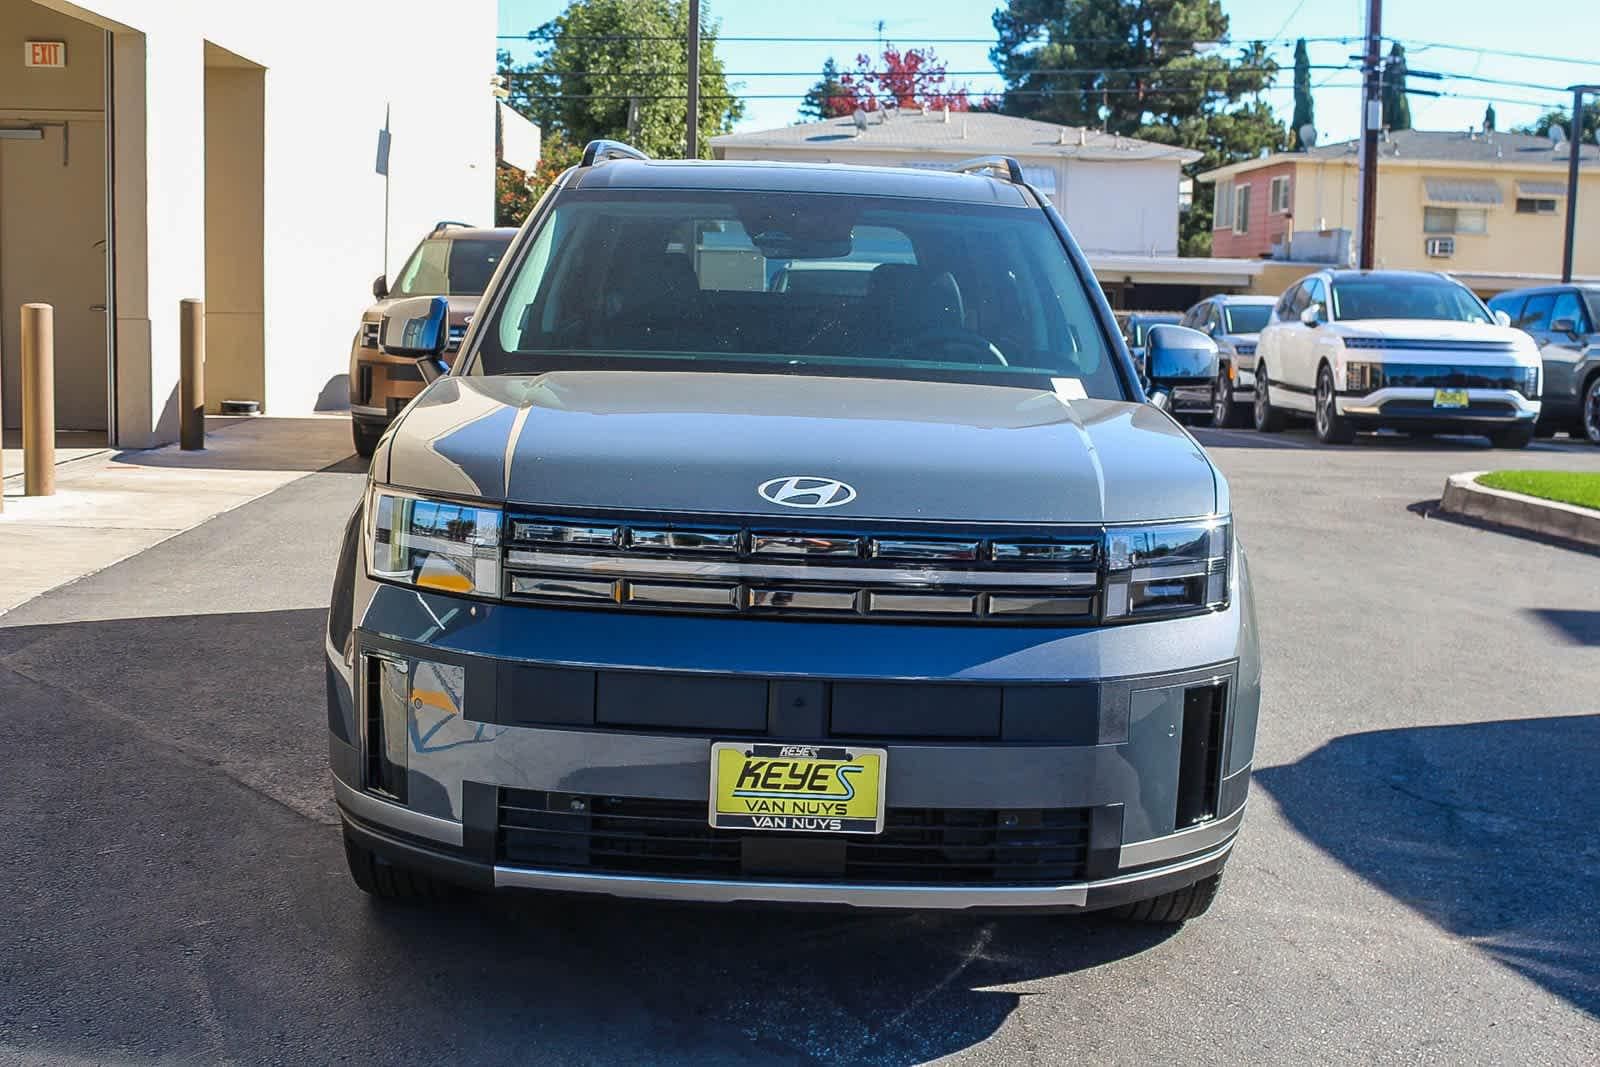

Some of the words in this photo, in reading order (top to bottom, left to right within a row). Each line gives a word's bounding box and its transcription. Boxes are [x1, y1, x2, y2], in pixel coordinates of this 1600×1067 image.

[32, 44, 60, 65] EXIT
[779, 746, 820, 759] KEYES
[732, 760, 864, 801] KEYES
[745, 800, 786, 814] VAN
[792, 801, 848, 815] NUYS
[752, 816, 787, 829] VAN
[792, 818, 842, 830] NUYS
